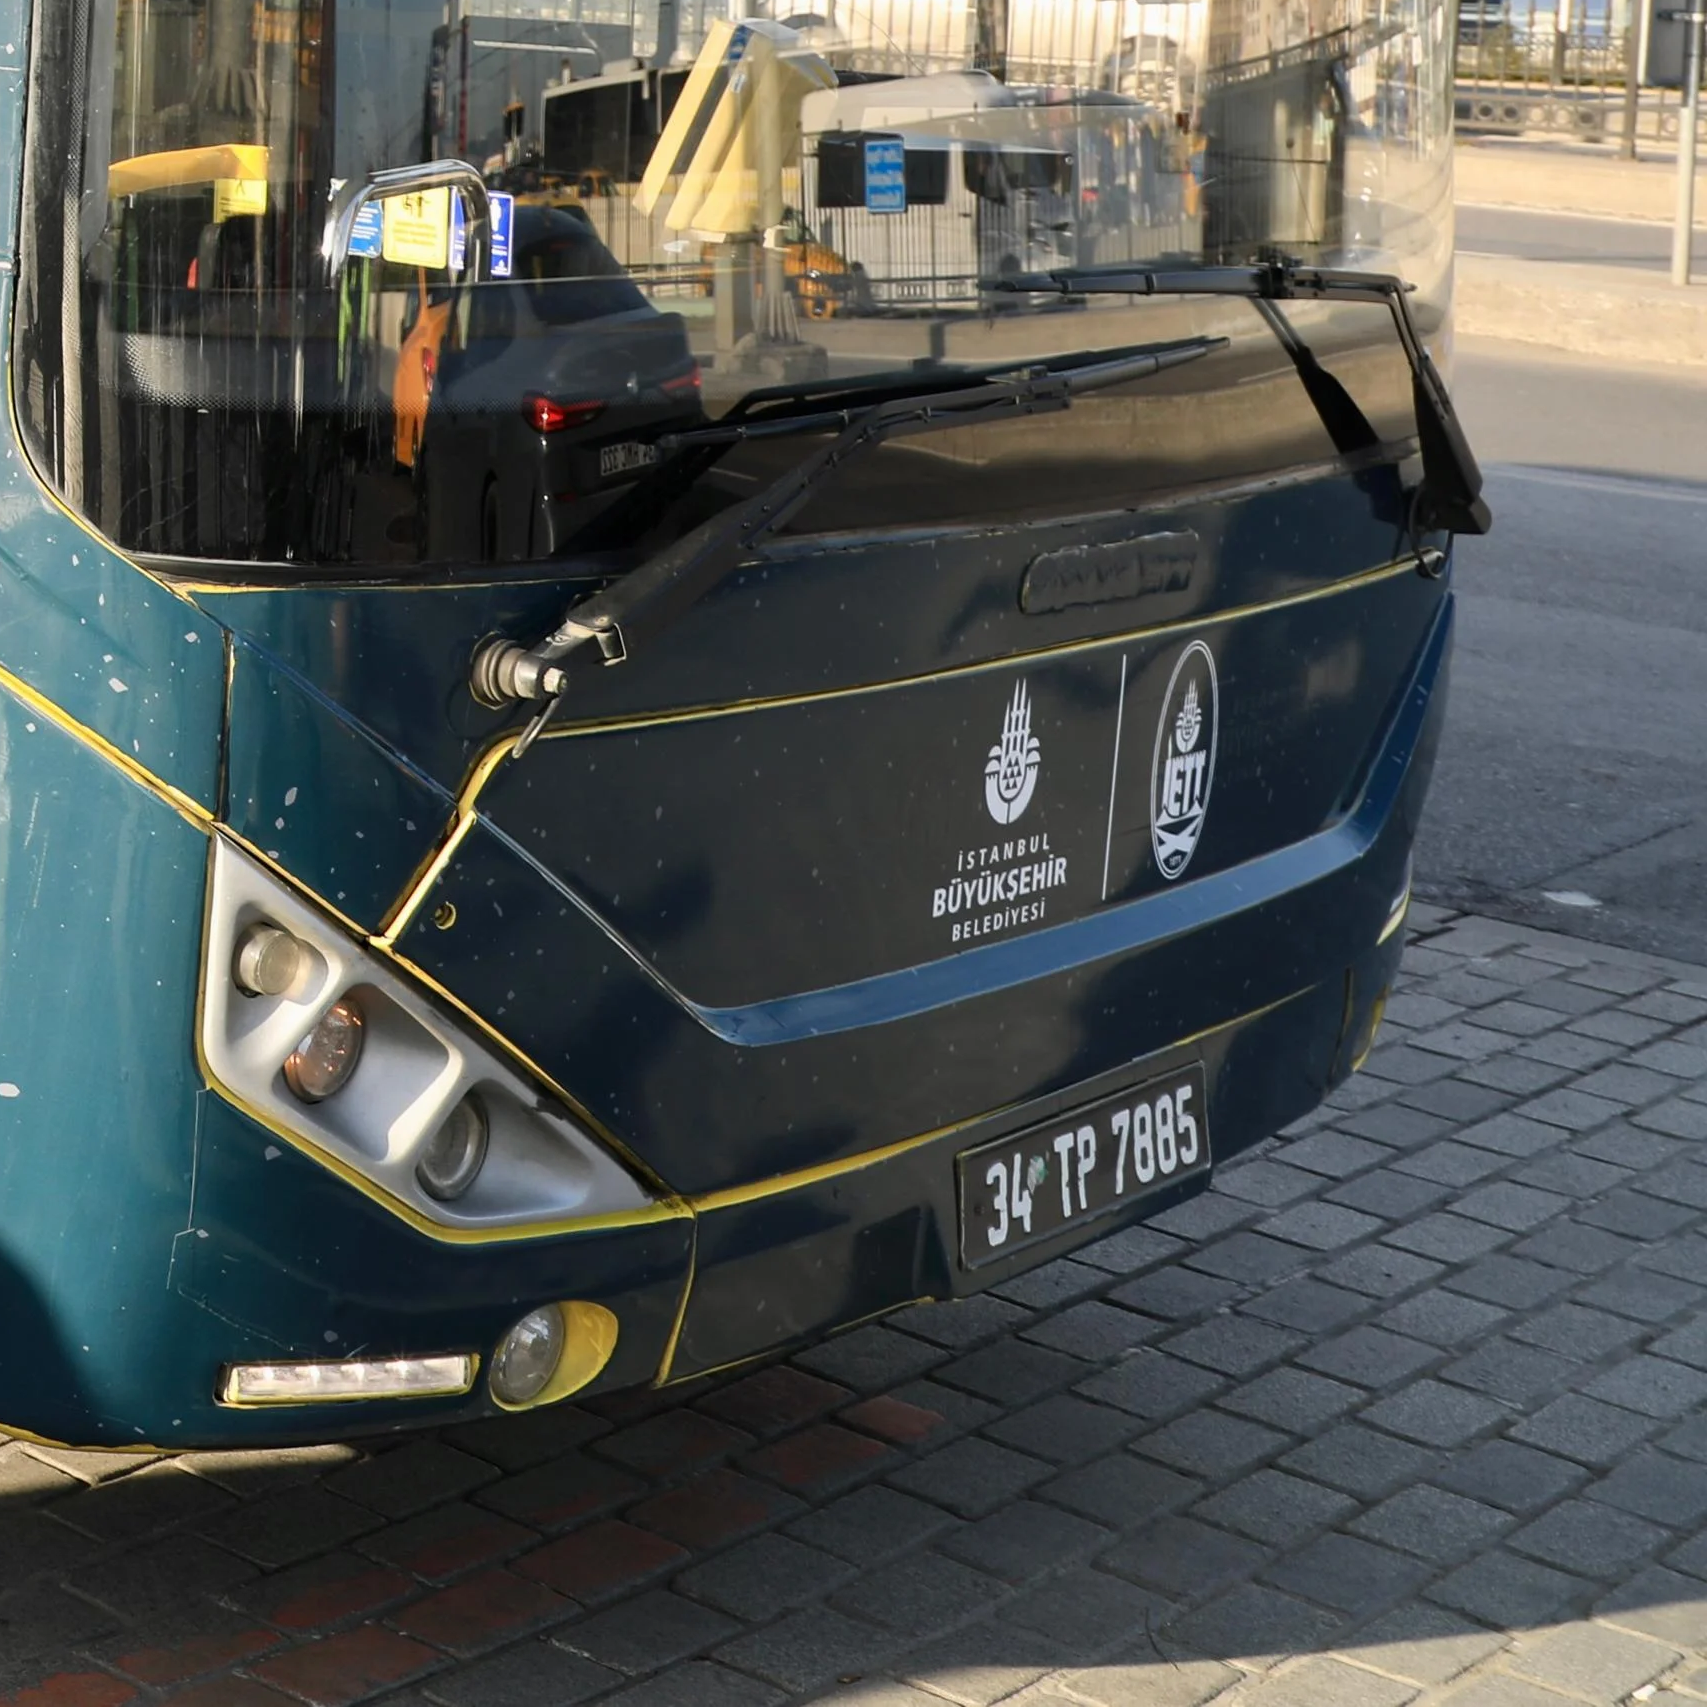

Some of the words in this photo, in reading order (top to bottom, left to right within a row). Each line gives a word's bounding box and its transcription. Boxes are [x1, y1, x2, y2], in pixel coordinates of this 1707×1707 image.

[957, 833, 1050, 872] İSTANBUL
[932, 852, 1068, 918] BÜYÜKŞEHİR
[951, 897, 1046, 943] BELEDİYESİ
[987, 1151, 1032, 1248] 34
[1054, 1124, 1097, 1218] TP
[1111, 1084, 1199, 1195] 7885
